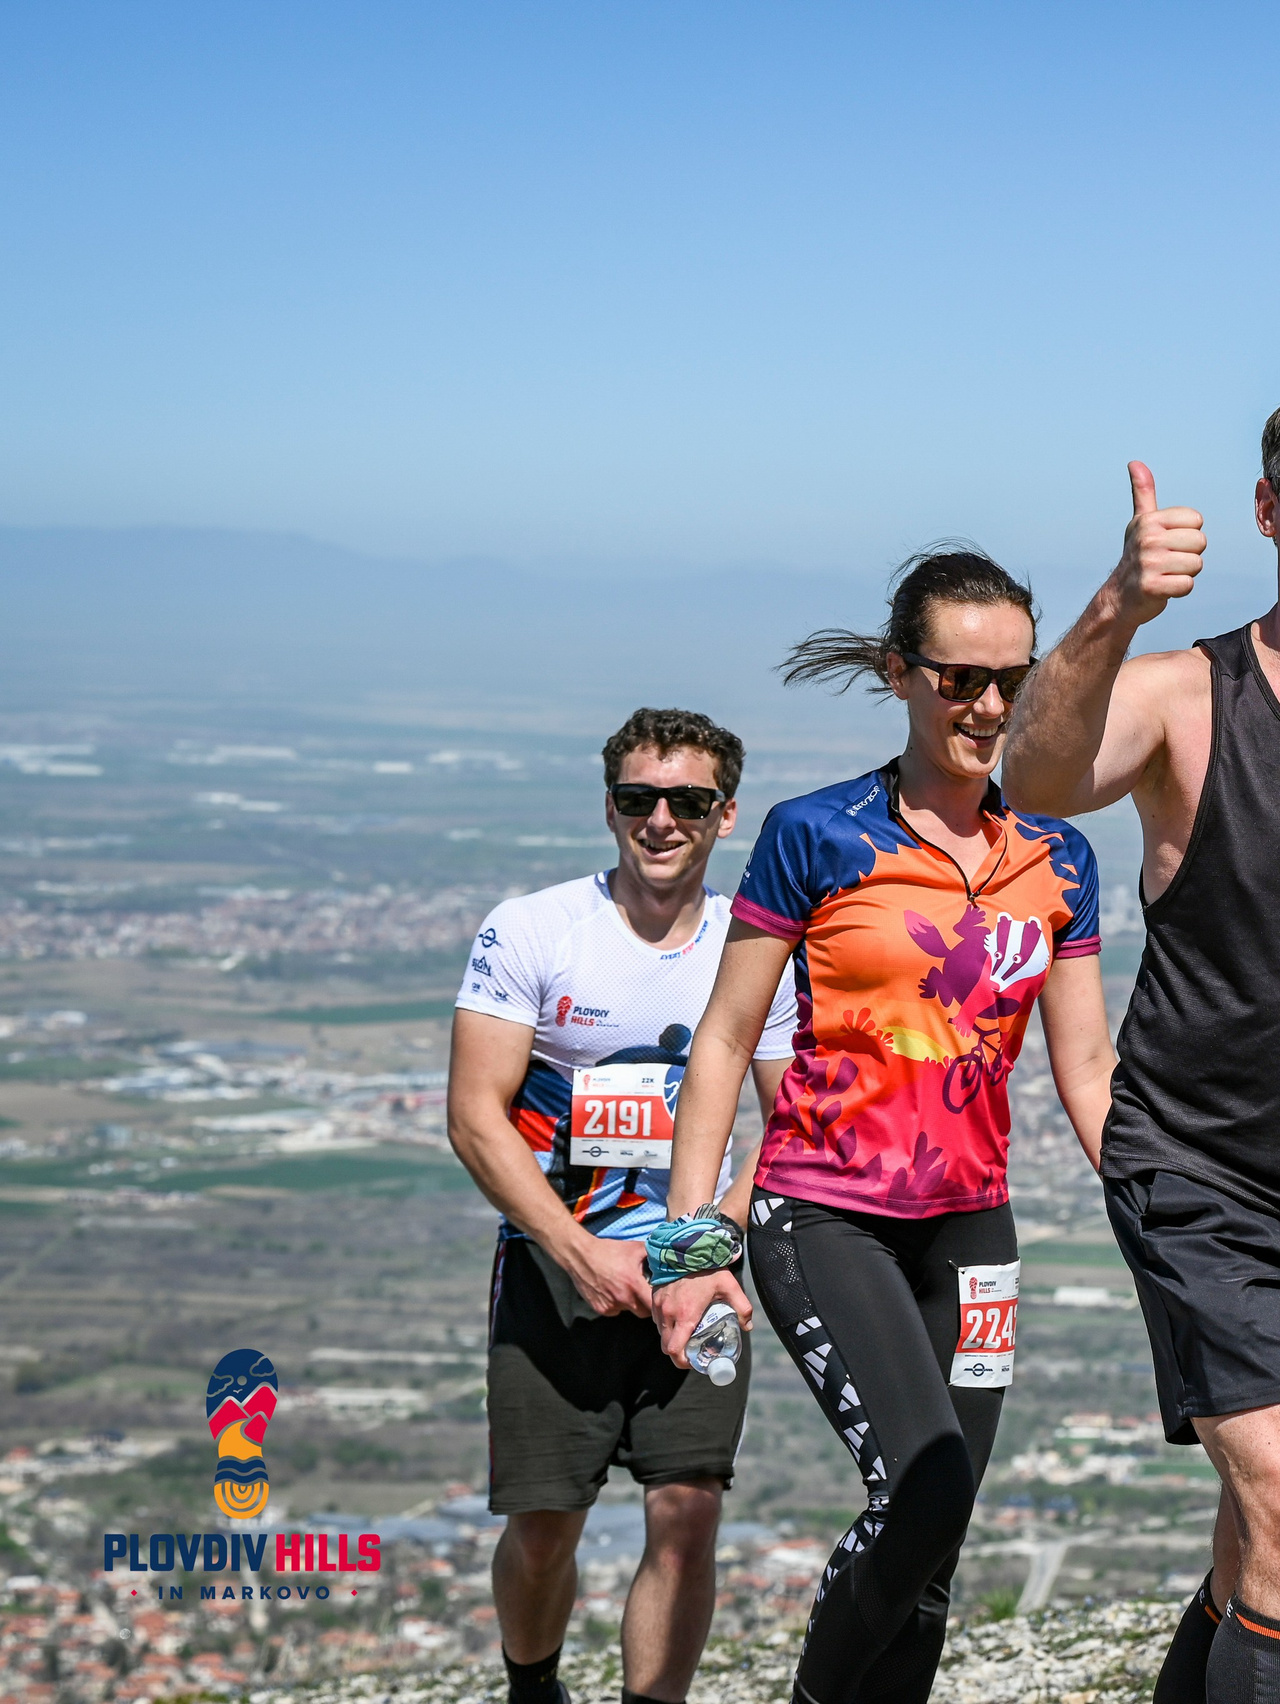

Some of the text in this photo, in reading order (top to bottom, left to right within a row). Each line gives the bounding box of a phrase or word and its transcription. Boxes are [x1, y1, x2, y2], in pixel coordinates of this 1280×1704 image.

[570, 1015, 595, 1027] HILLS
[573, 1006, 610, 1018] PLOVDIV
[583, 1099, 653, 1137] 2191
[962, 1305, 1018, 1348] 224
